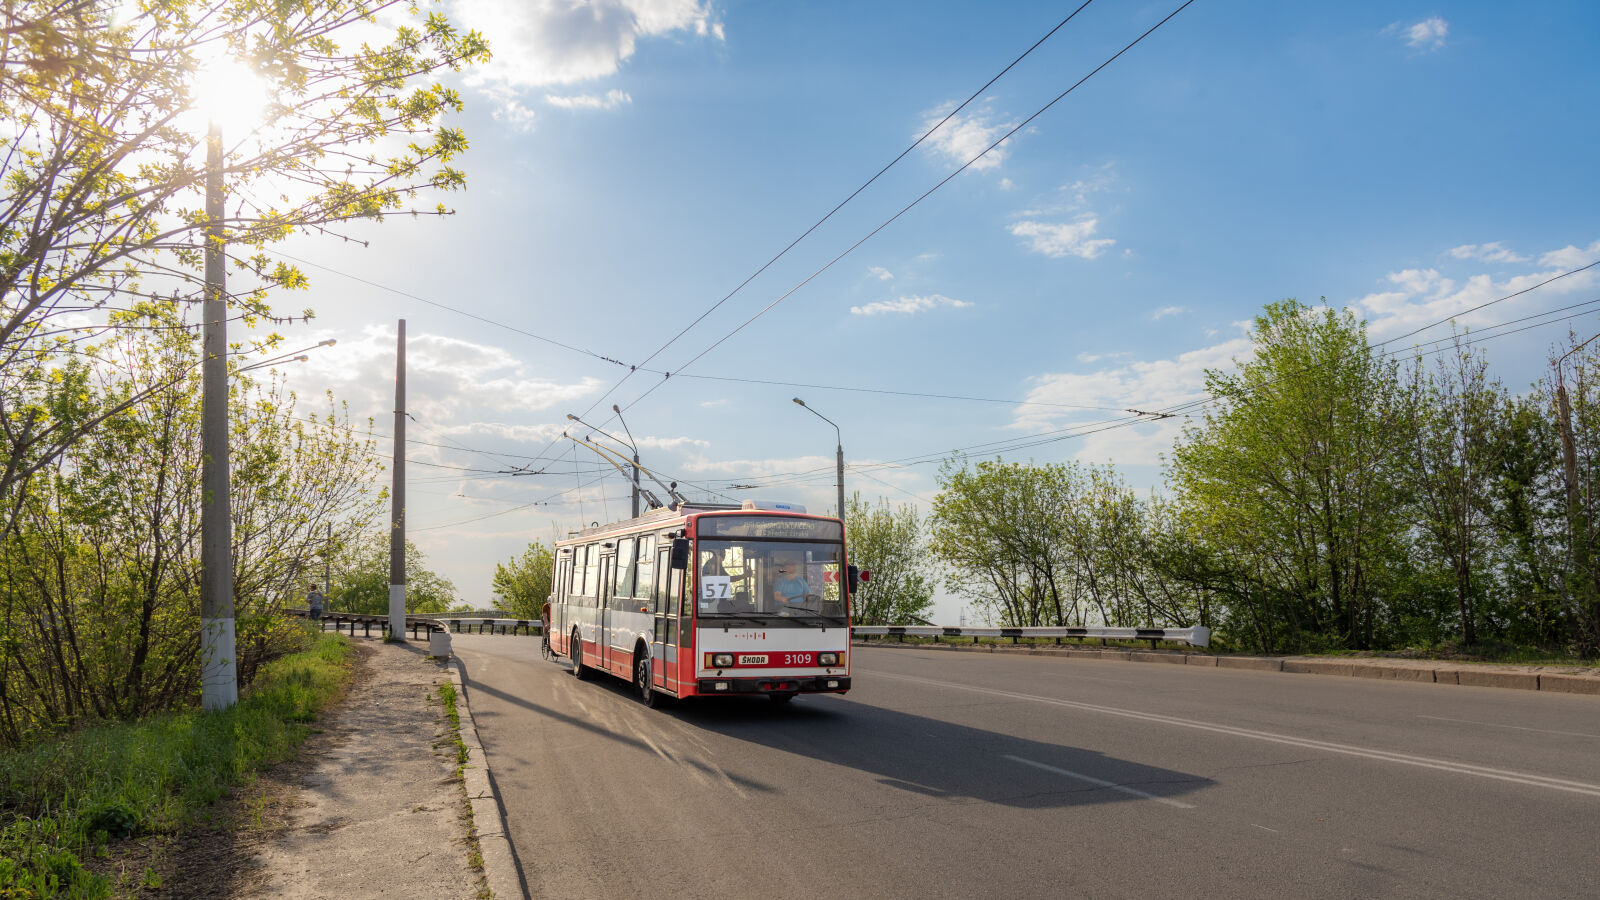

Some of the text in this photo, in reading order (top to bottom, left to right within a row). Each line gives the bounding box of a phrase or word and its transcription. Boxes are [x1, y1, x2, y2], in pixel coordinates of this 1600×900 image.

[705, 583, 728, 598] 57
[741, 655, 766, 664] ŠKODA
[784, 653, 812, 665] 3109
